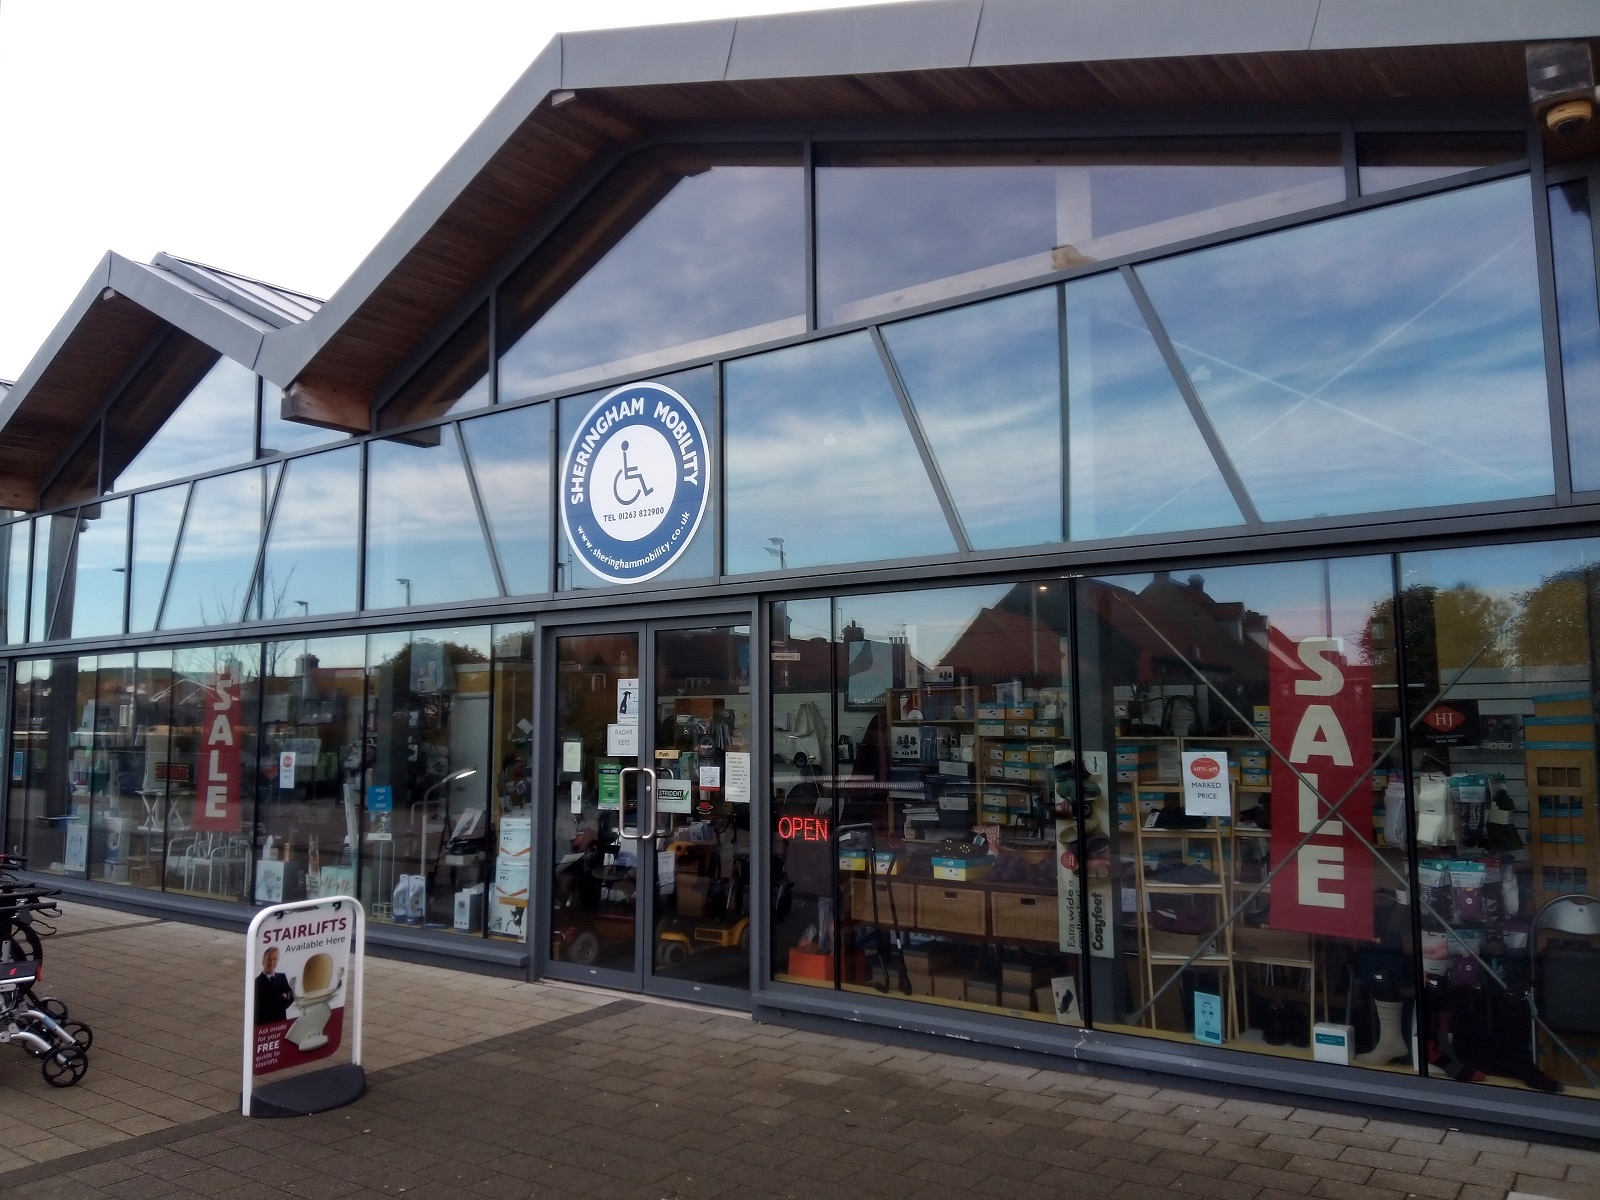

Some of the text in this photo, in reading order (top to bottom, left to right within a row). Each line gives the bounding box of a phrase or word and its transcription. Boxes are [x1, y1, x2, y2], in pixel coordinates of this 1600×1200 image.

[570, 396, 699, 505] SHERINGHAM MOBILITY
[603, 506, 665, 522] TEL 01263 822900
[577, 510, 691, 570] www.sheringhammobility.co.uk
[1435, 712, 1454, 728] HJ
[205, 679, 234, 818] SALE
[1288, 636, 1354, 910] SALE
[658, 789, 683, 798] STRIDENT
[778, 816, 828, 842] OPEN
[1066, 889, 1075, 921] wide
[262, 917, 347, 944] STAIRLIFTS
[1091, 893, 1106, 951] Cosyfeet
[285, 936, 346, 954] Available Here
[1066, 923, 1075, 949] Extra
[258, 1024, 287, 1036] Ask inside
[267, 1033, 281, 1042] your
[257, 1040, 280, 1054] FREE
